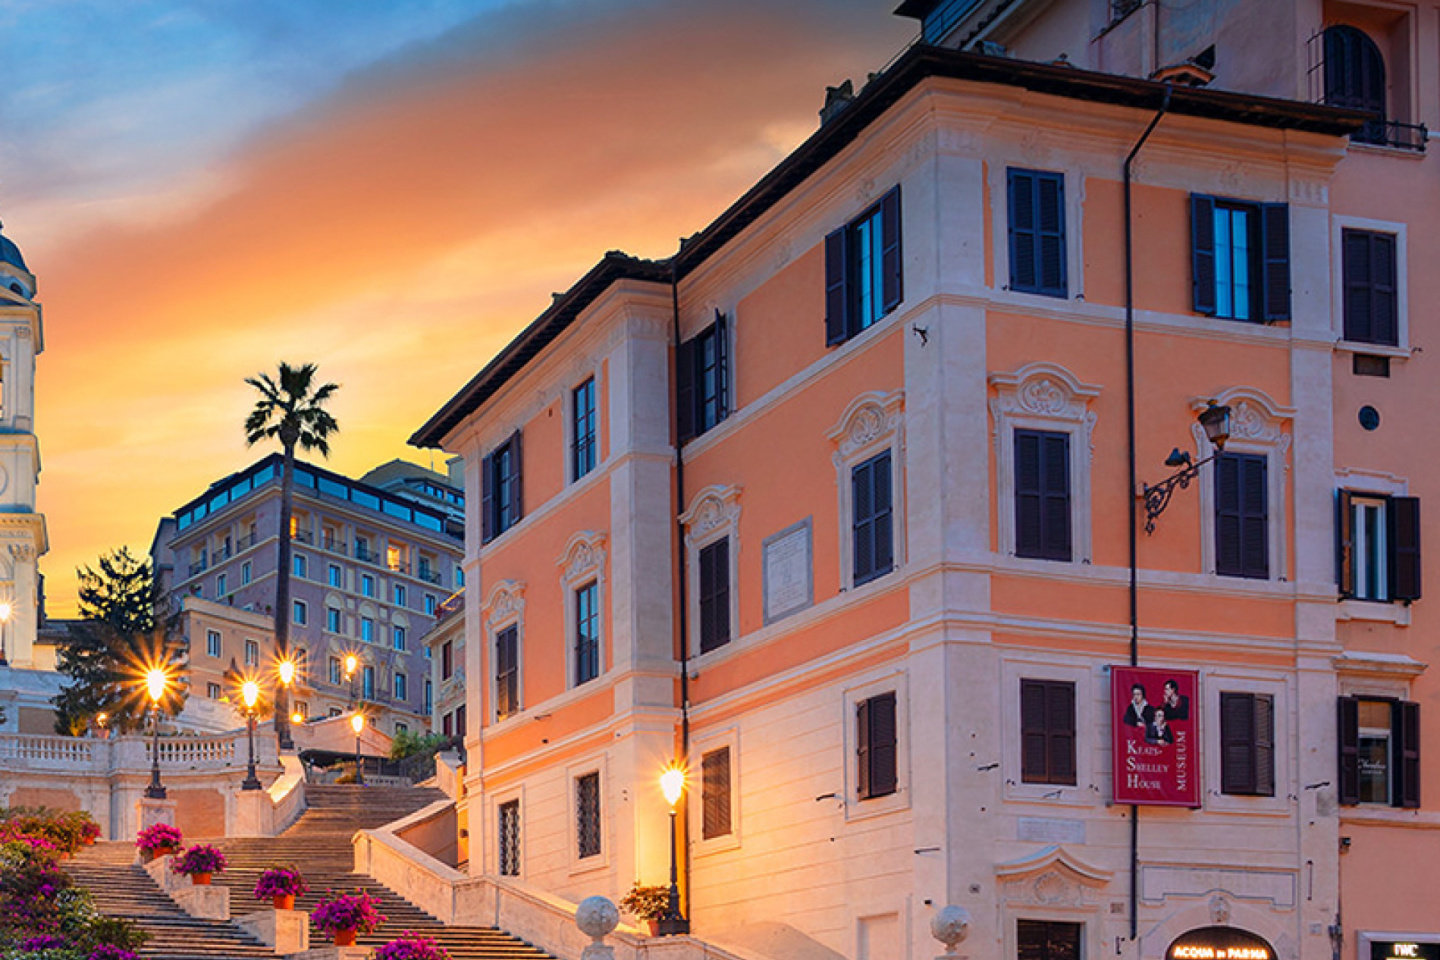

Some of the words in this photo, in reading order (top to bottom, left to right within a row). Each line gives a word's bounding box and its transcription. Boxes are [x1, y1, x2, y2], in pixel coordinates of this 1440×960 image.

[1176, 730, 1187, 792] MUSEUM
[1173, 945, 1215, 958] ACQUA
[1227, 946, 1269, 960] PARMA
